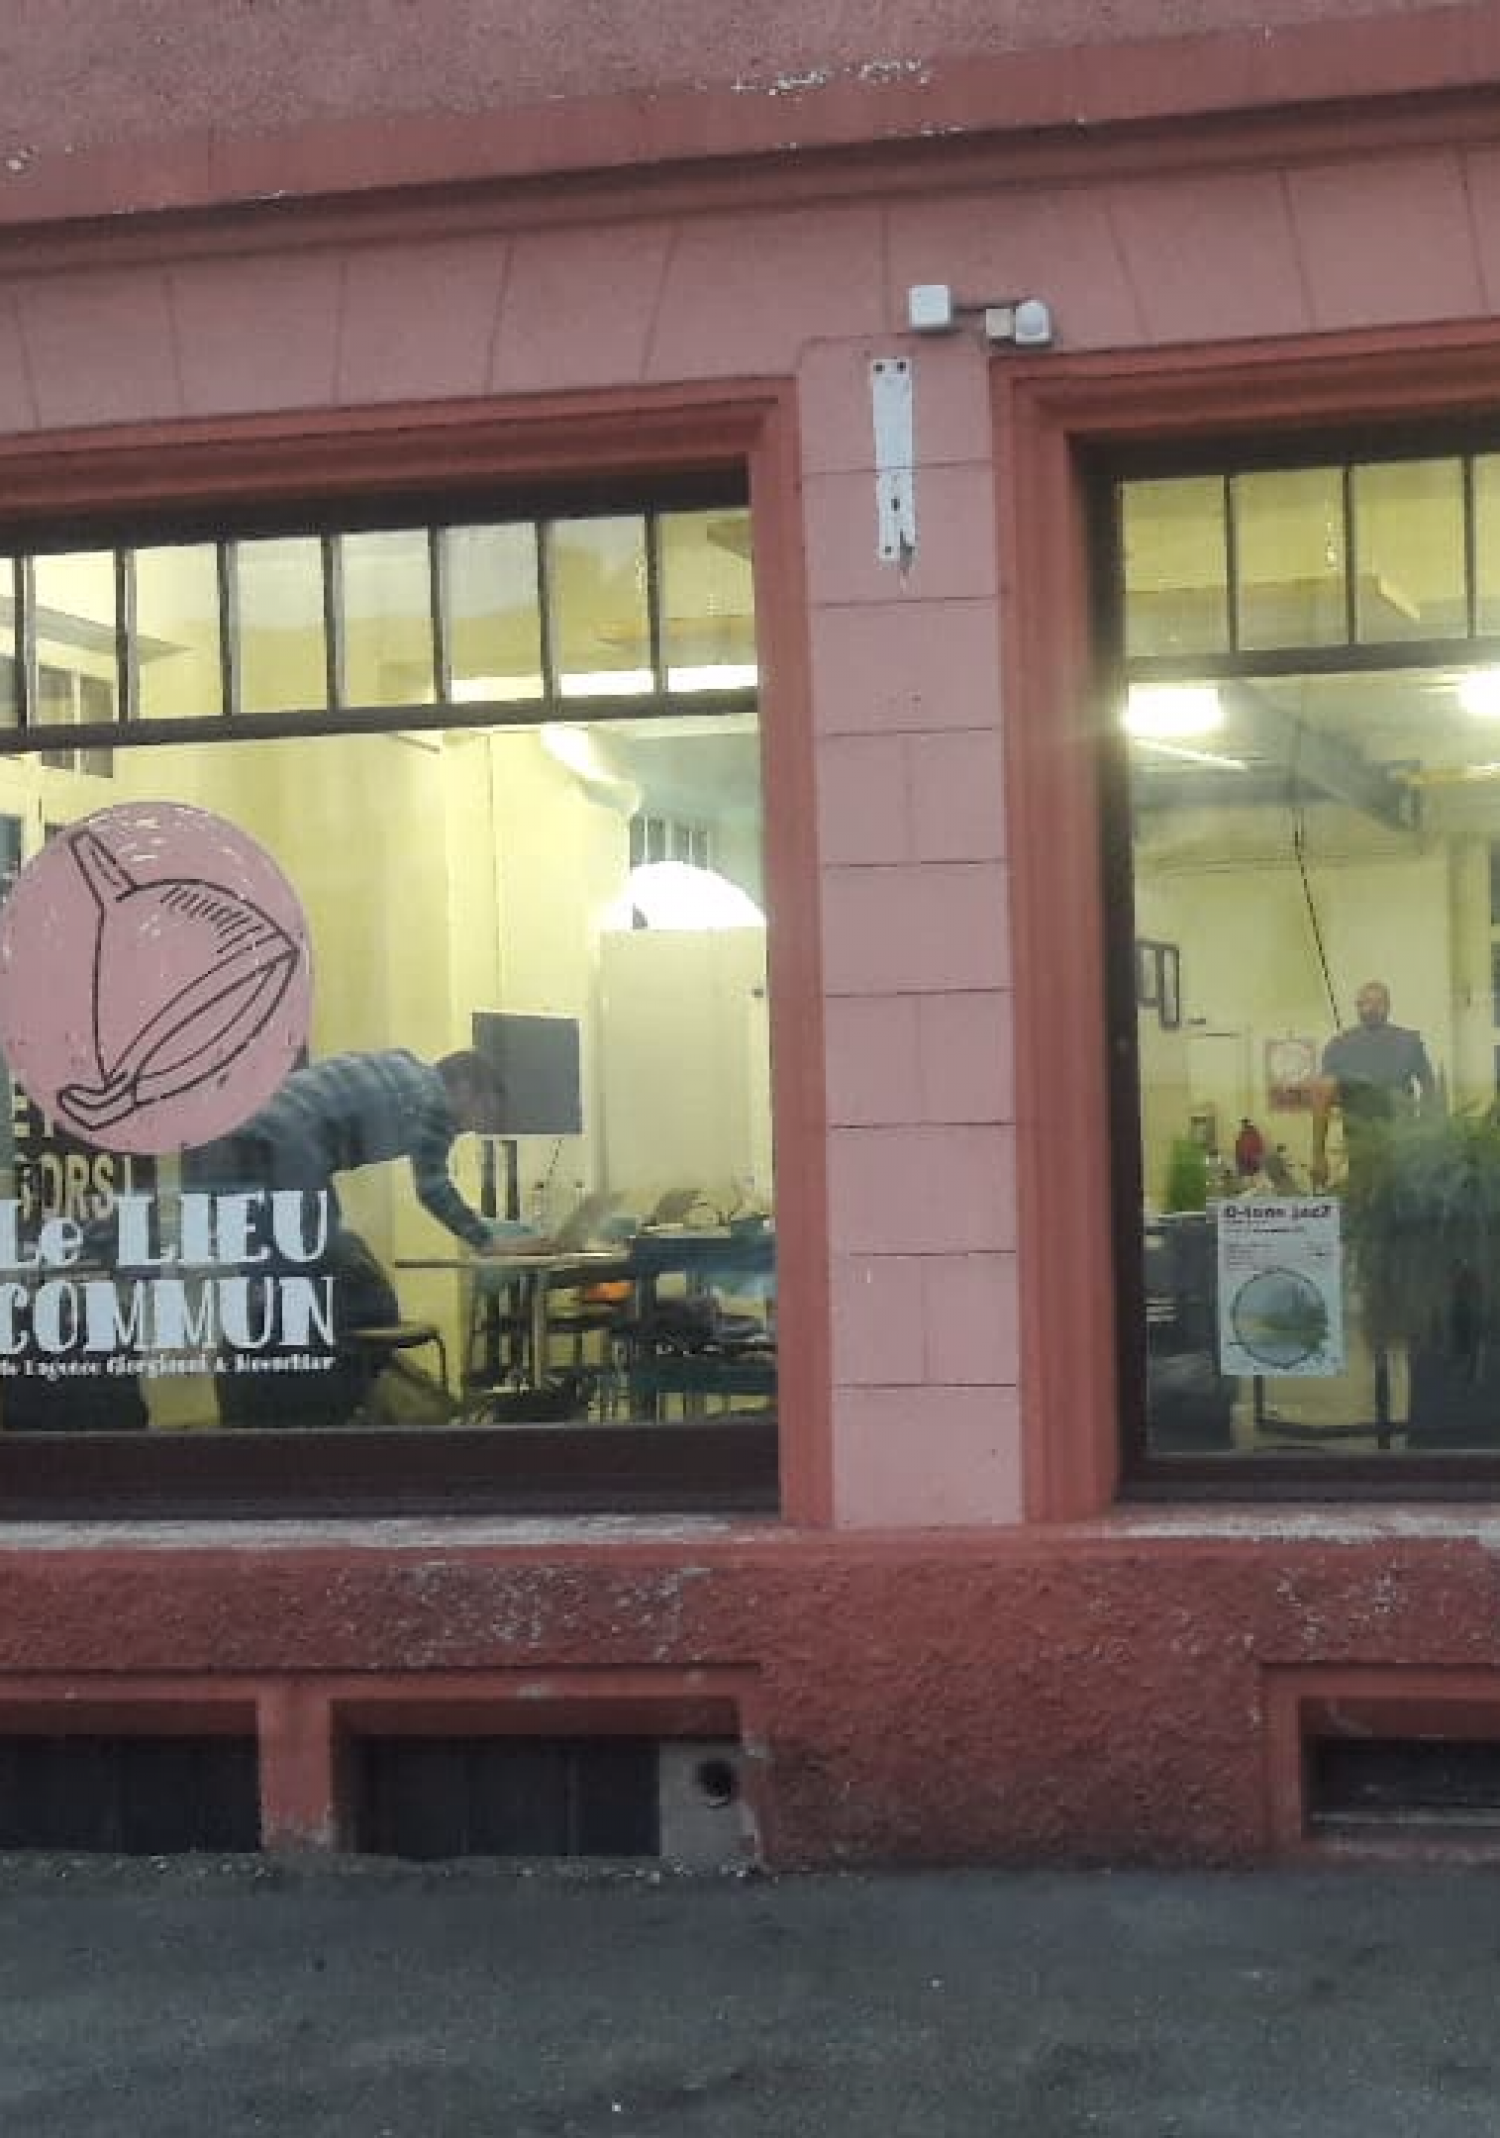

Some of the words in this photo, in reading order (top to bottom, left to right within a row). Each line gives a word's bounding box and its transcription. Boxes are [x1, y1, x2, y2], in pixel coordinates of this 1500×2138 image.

[0, 1198, 83, 1269] Le
[113, 1190, 328, 1266] LIEU
[0, 1277, 336, 1354] COMMUN
